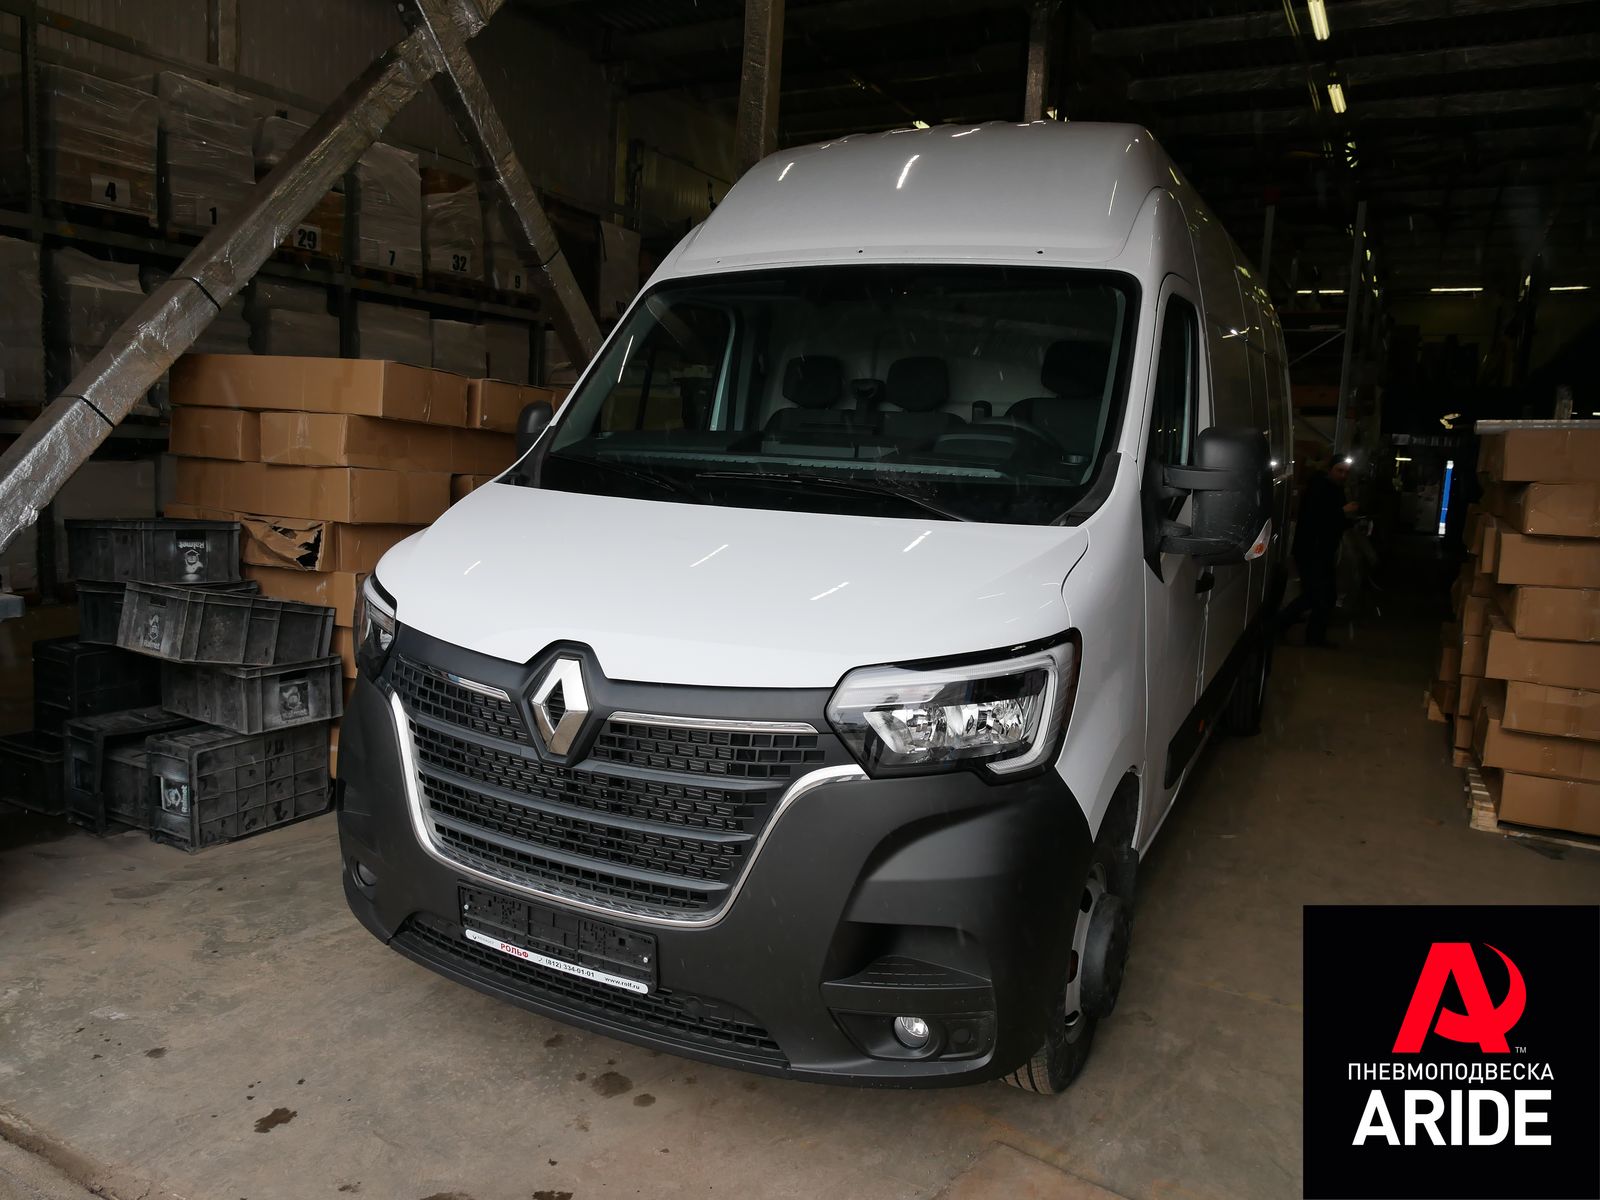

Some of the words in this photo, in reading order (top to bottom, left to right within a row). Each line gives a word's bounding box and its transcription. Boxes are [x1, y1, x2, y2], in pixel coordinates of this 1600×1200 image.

[105, 181, 117, 201] 4
[208, 206, 217, 225] 1
[297, 228, 317, 249] 29
[388, 249, 396, 266] 7
[452, 254, 467, 271] 32
[514, 275, 521, 288] 9
[500, 943, 529, 958] РОЛЬФ
[545, 959, 562, 969] (812)
[563, 964, 595, 978] 334-01-01
[605, 977, 640, 990] www.rolf.ru
